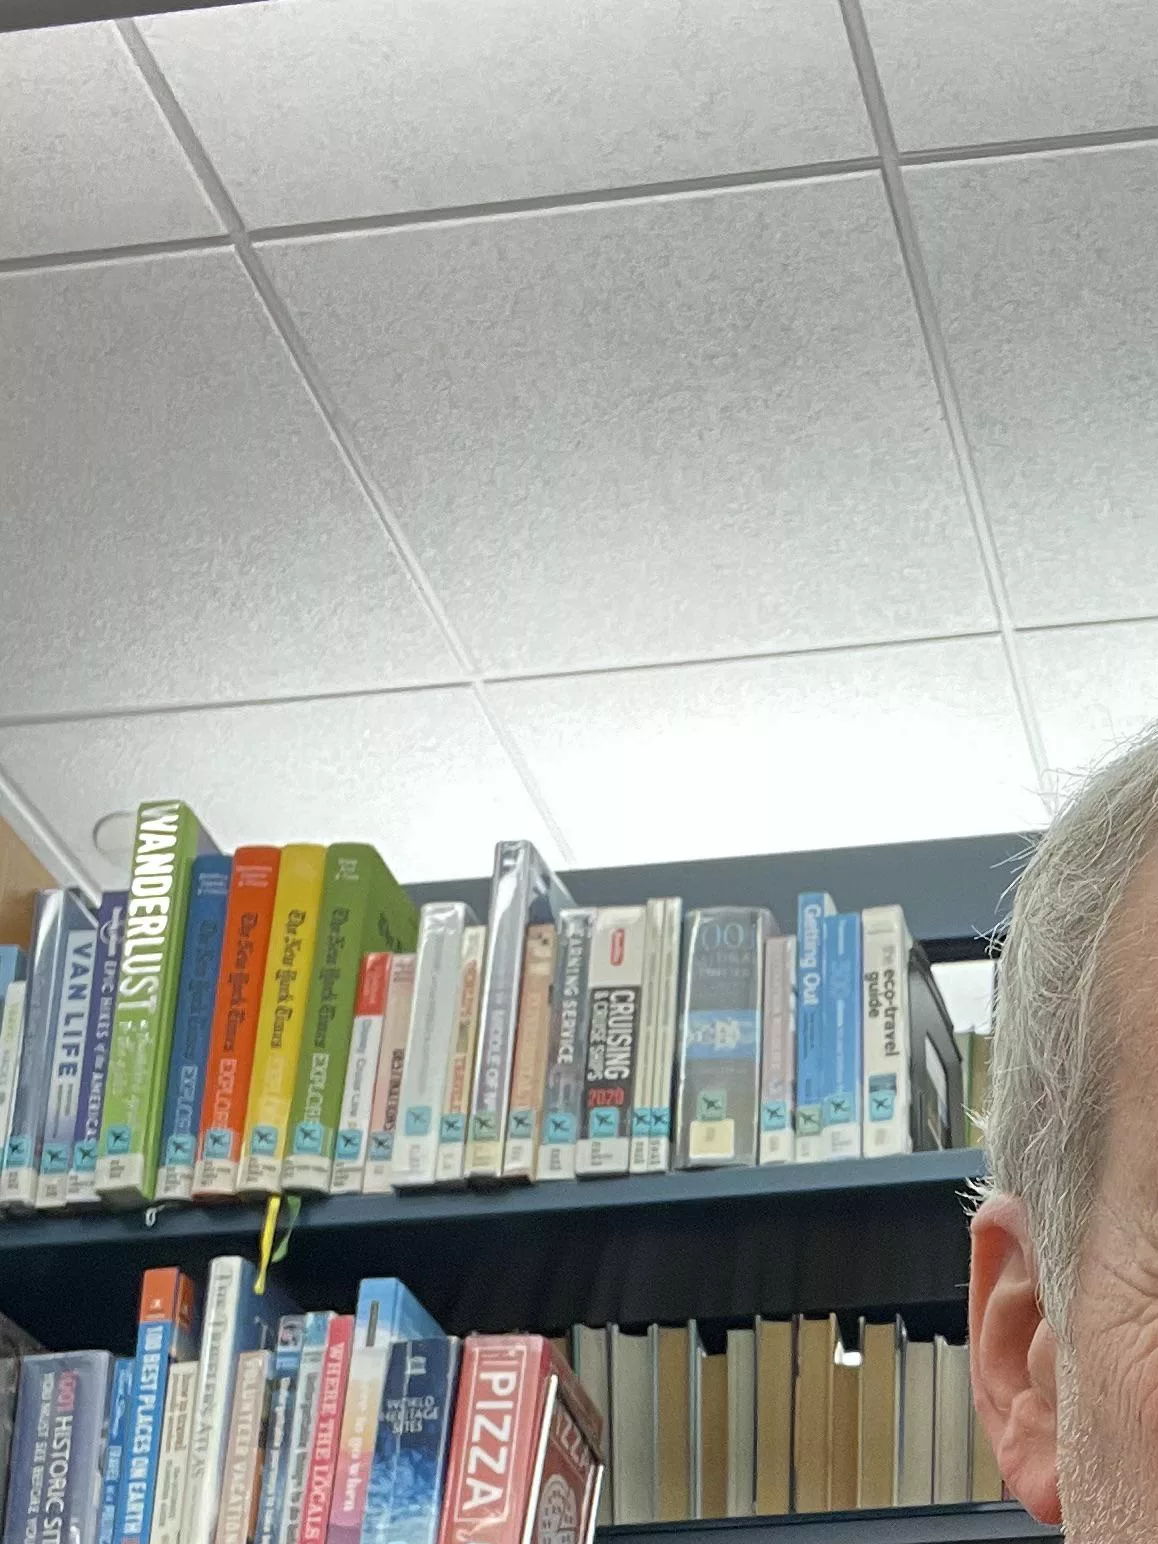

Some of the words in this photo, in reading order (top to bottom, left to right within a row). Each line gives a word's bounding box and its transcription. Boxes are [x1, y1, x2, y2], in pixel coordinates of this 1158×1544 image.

[118, 801, 181, 1012] WANDERLUST
[800, 904, 821, 969] Getting
[66, 941, 93, 1000] VAN
[100, 959, 117, 995] EPIC
[802, 972, 820, 1006] Out
[865, 971, 879, 1018] guide
[95, 996, 112, 1038] HIKES
[557, 999, 577, 1064] SERVICE
[605, 990, 635, 1080] CRUISING
[883, 969, 900, 1056] eco-travel
[58, 1012, 85, 1078] LIFE
[82, 1071, 103, 1143] AMERICA
[145, 1327, 163, 1350] 100
[141, 1354, 159, 1392] BEST
[320, 1340, 344, 1414] WHERE
[387, 1395, 435, 1410] WORLD
[132, 1396, 156, 1455] PLACES
[233, 1356, 260, 1457] VOLUNTEER
[46, 1416, 73, 1514] HISTORIC
[314, 1417, 334, 1459] THE
[347, 1436, 362, 1458] go
[462, 1372, 517, 1511] PIZZA
[129, 1457, 147, 1480] ON
[342, 1462, 363, 1512] when
[124, 1482, 147, 1535] EARTH
[303, 1462, 331, 1540] LOCALS
